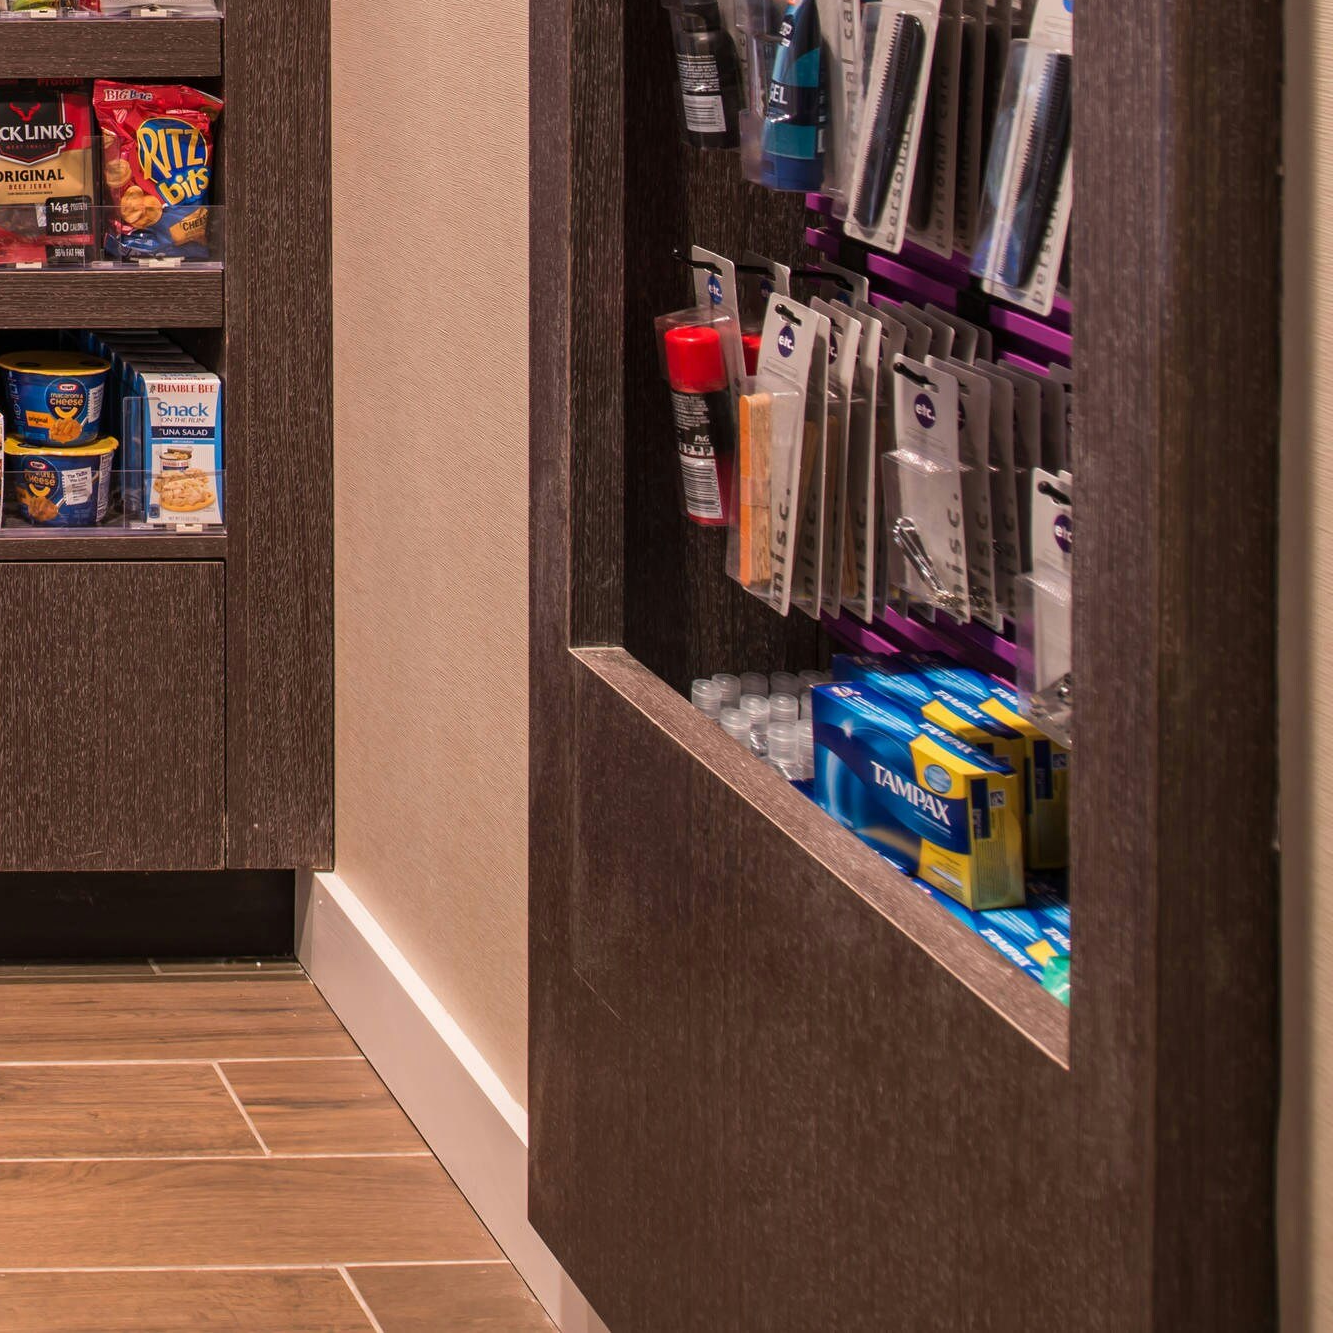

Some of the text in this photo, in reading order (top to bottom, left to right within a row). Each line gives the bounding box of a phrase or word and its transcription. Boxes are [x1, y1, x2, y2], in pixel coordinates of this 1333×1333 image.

[25, 124, 74, 140] LINK'S
[137, 127, 205, 183] RITZ
[159, 166, 210, 206] bits
[779, 334, 795, 349] etc.
[157, 384, 196, 394] BUMBLE
[157, 401, 209, 417] Snack
[915, 404, 935, 419] etc.
[183, 428, 208, 436] SALAD
[870, 760, 952, 826] TAMPAX
